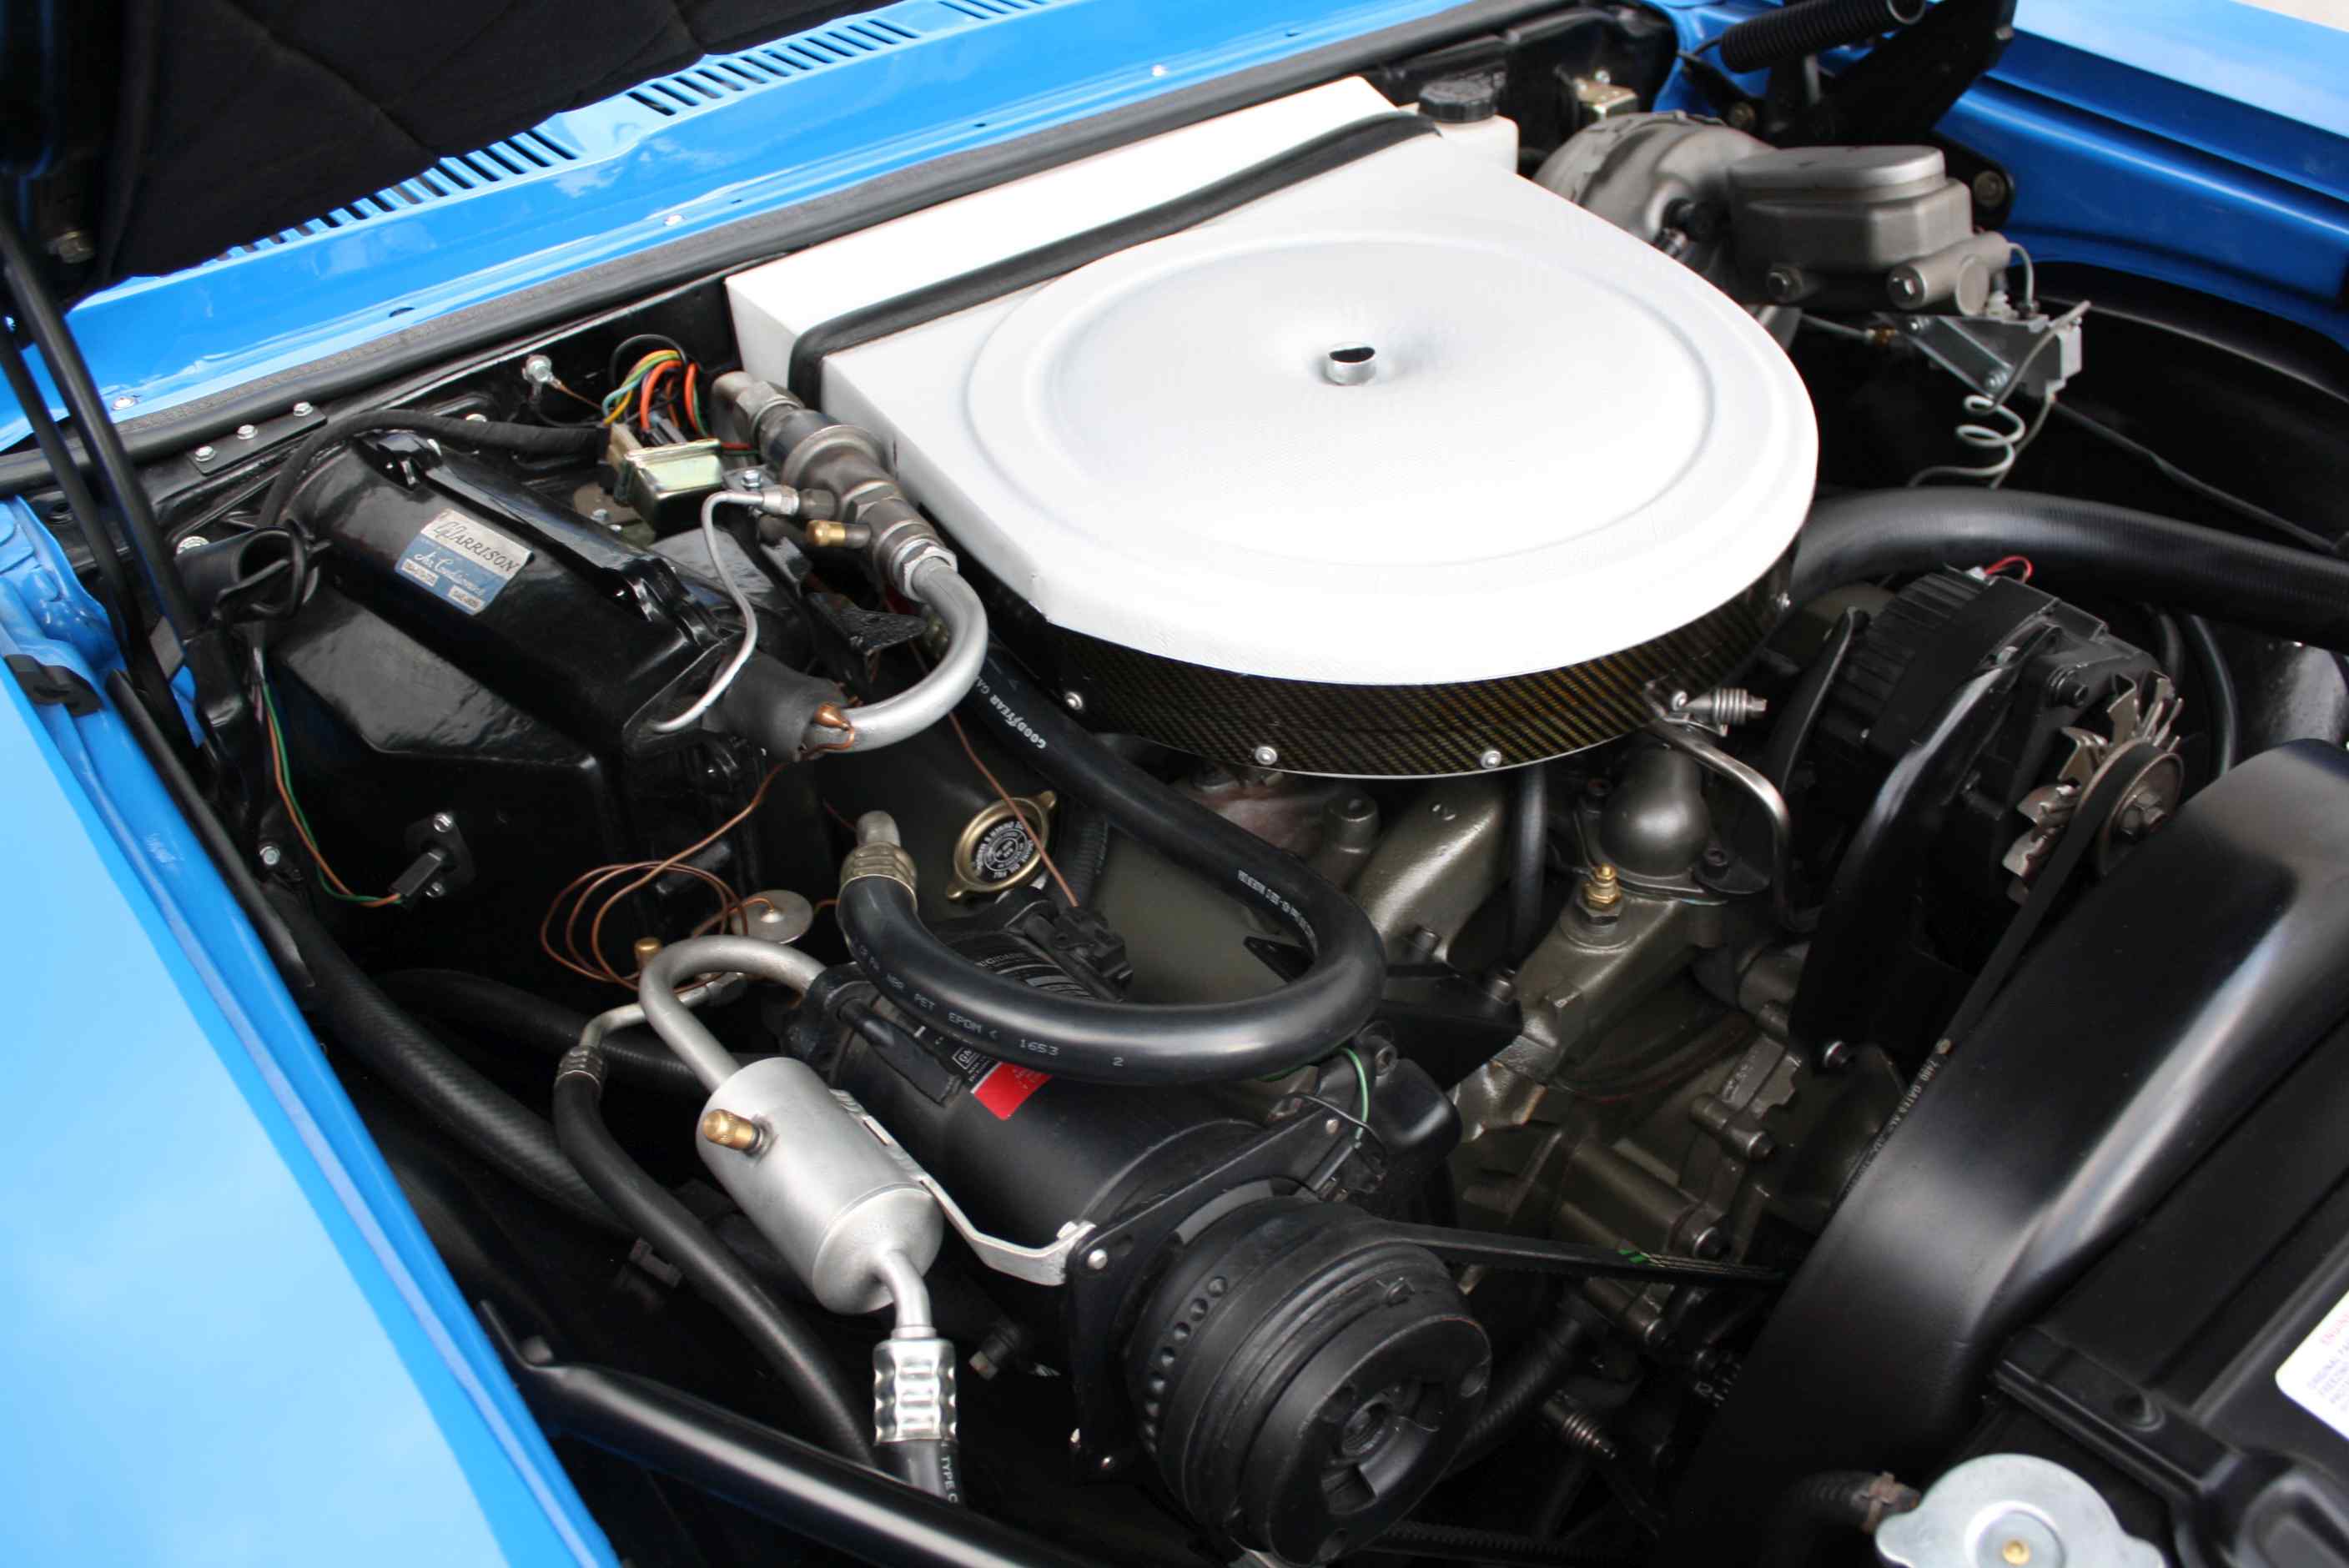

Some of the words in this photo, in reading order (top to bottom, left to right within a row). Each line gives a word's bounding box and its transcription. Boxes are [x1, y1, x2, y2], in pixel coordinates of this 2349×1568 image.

[433, 520, 520, 573] HARRISON
[988, 693, 1047, 749] GOODYEAR
[1019, 1038, 1059, 1057] 1653
[940, 1455, 955, 1490] TYPE
[948, 1492, 958, 1504] C
